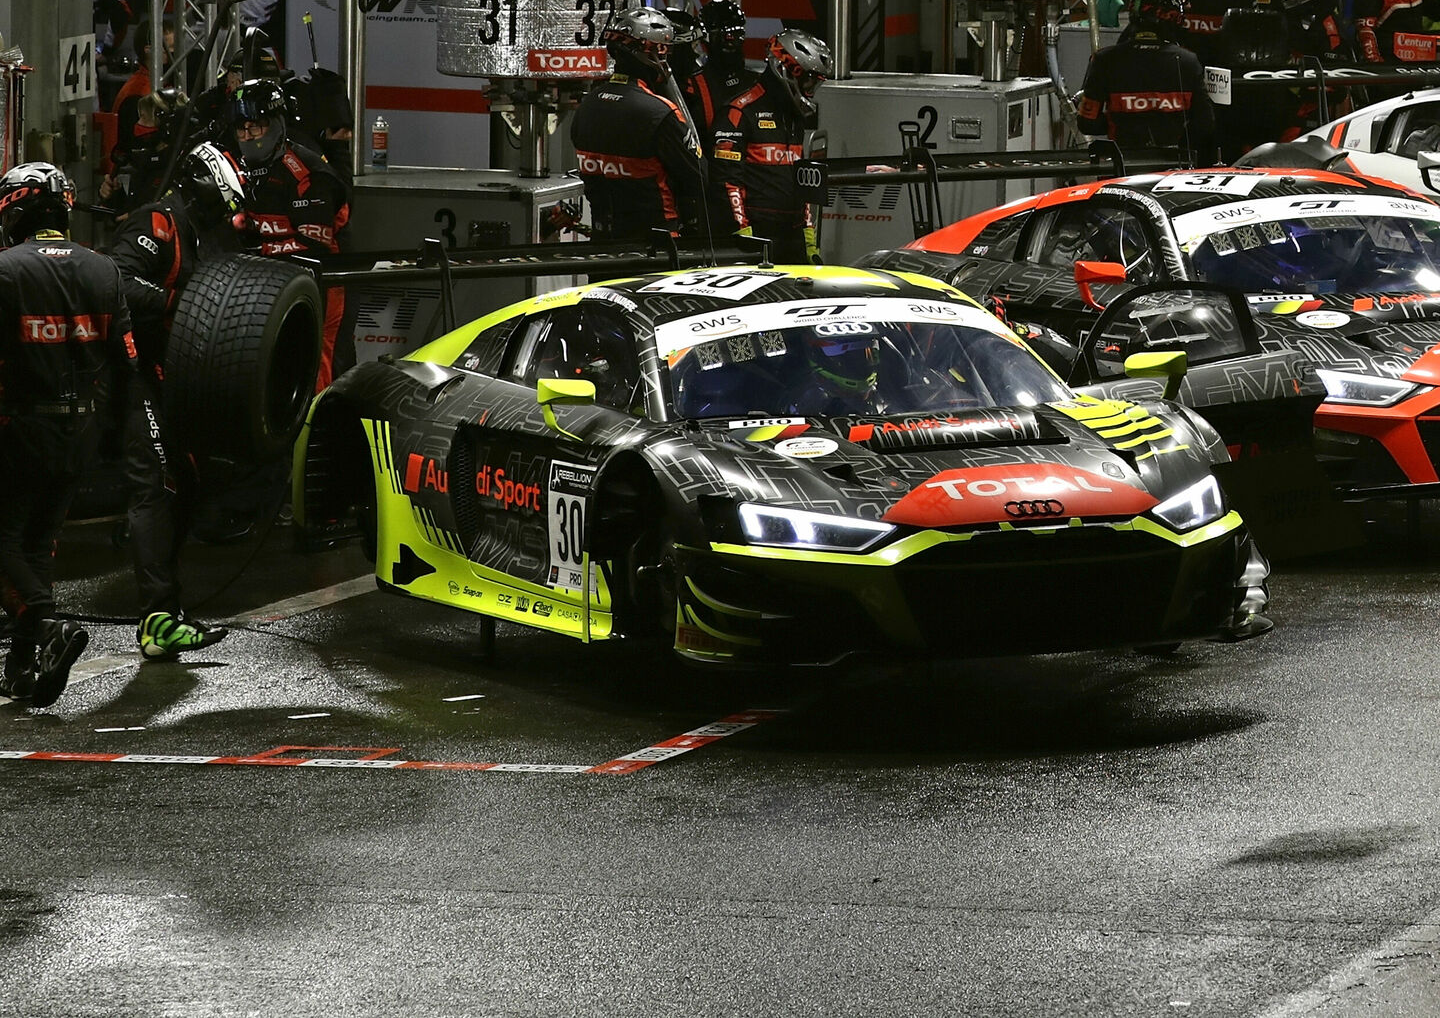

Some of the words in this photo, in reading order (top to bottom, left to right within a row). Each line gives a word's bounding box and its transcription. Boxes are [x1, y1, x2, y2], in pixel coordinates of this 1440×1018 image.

[1183, 18, 1223, 31] OTAL
[64, 41, 92, 94] 41
[535, 53, 603, 73] TOTAL
[1206, 71, 1230, 85] TOTAL
[1121, 95, 1185, 111] TOTAL
[917, 105, 939, 151] 2
[761, 146, 802, 163] TOTA
[576, 153, 633, 177] TOTAL
[1184, 175, 1237, 188] 31
[1289, 199, 1356, 211] GT
[1387, 201, 1427, 213] aws
[1211, 206, 1256, 221] aws
[435, 208, 457, 249] 3
[673, 273, 755, 289] 30
[687, 287, 717, 295] PRO
[1258, 294, 1305, 302] PRO
[783, 303, 869, 318] GT
[907, 303, 958, 317] aws
[27, 318, 99, 341] TOTAL
[688, 313, 743, 333] aws
[143, 399, 161, 440] Sport
[742, 419, 792, 427] PRO
[881, 416, 942, 436] Audi
[558, 467, 593, 486] REBELLION
[493, 466, 543, 512] Sport
[925, 475, 1114, 501] TOTAL
[555, 496, 584, 565] 30
[568, 571, 583, 587] PRO
[462, 585, 484, 599] Snap-on
[497, 593, 513, 604] OZ
